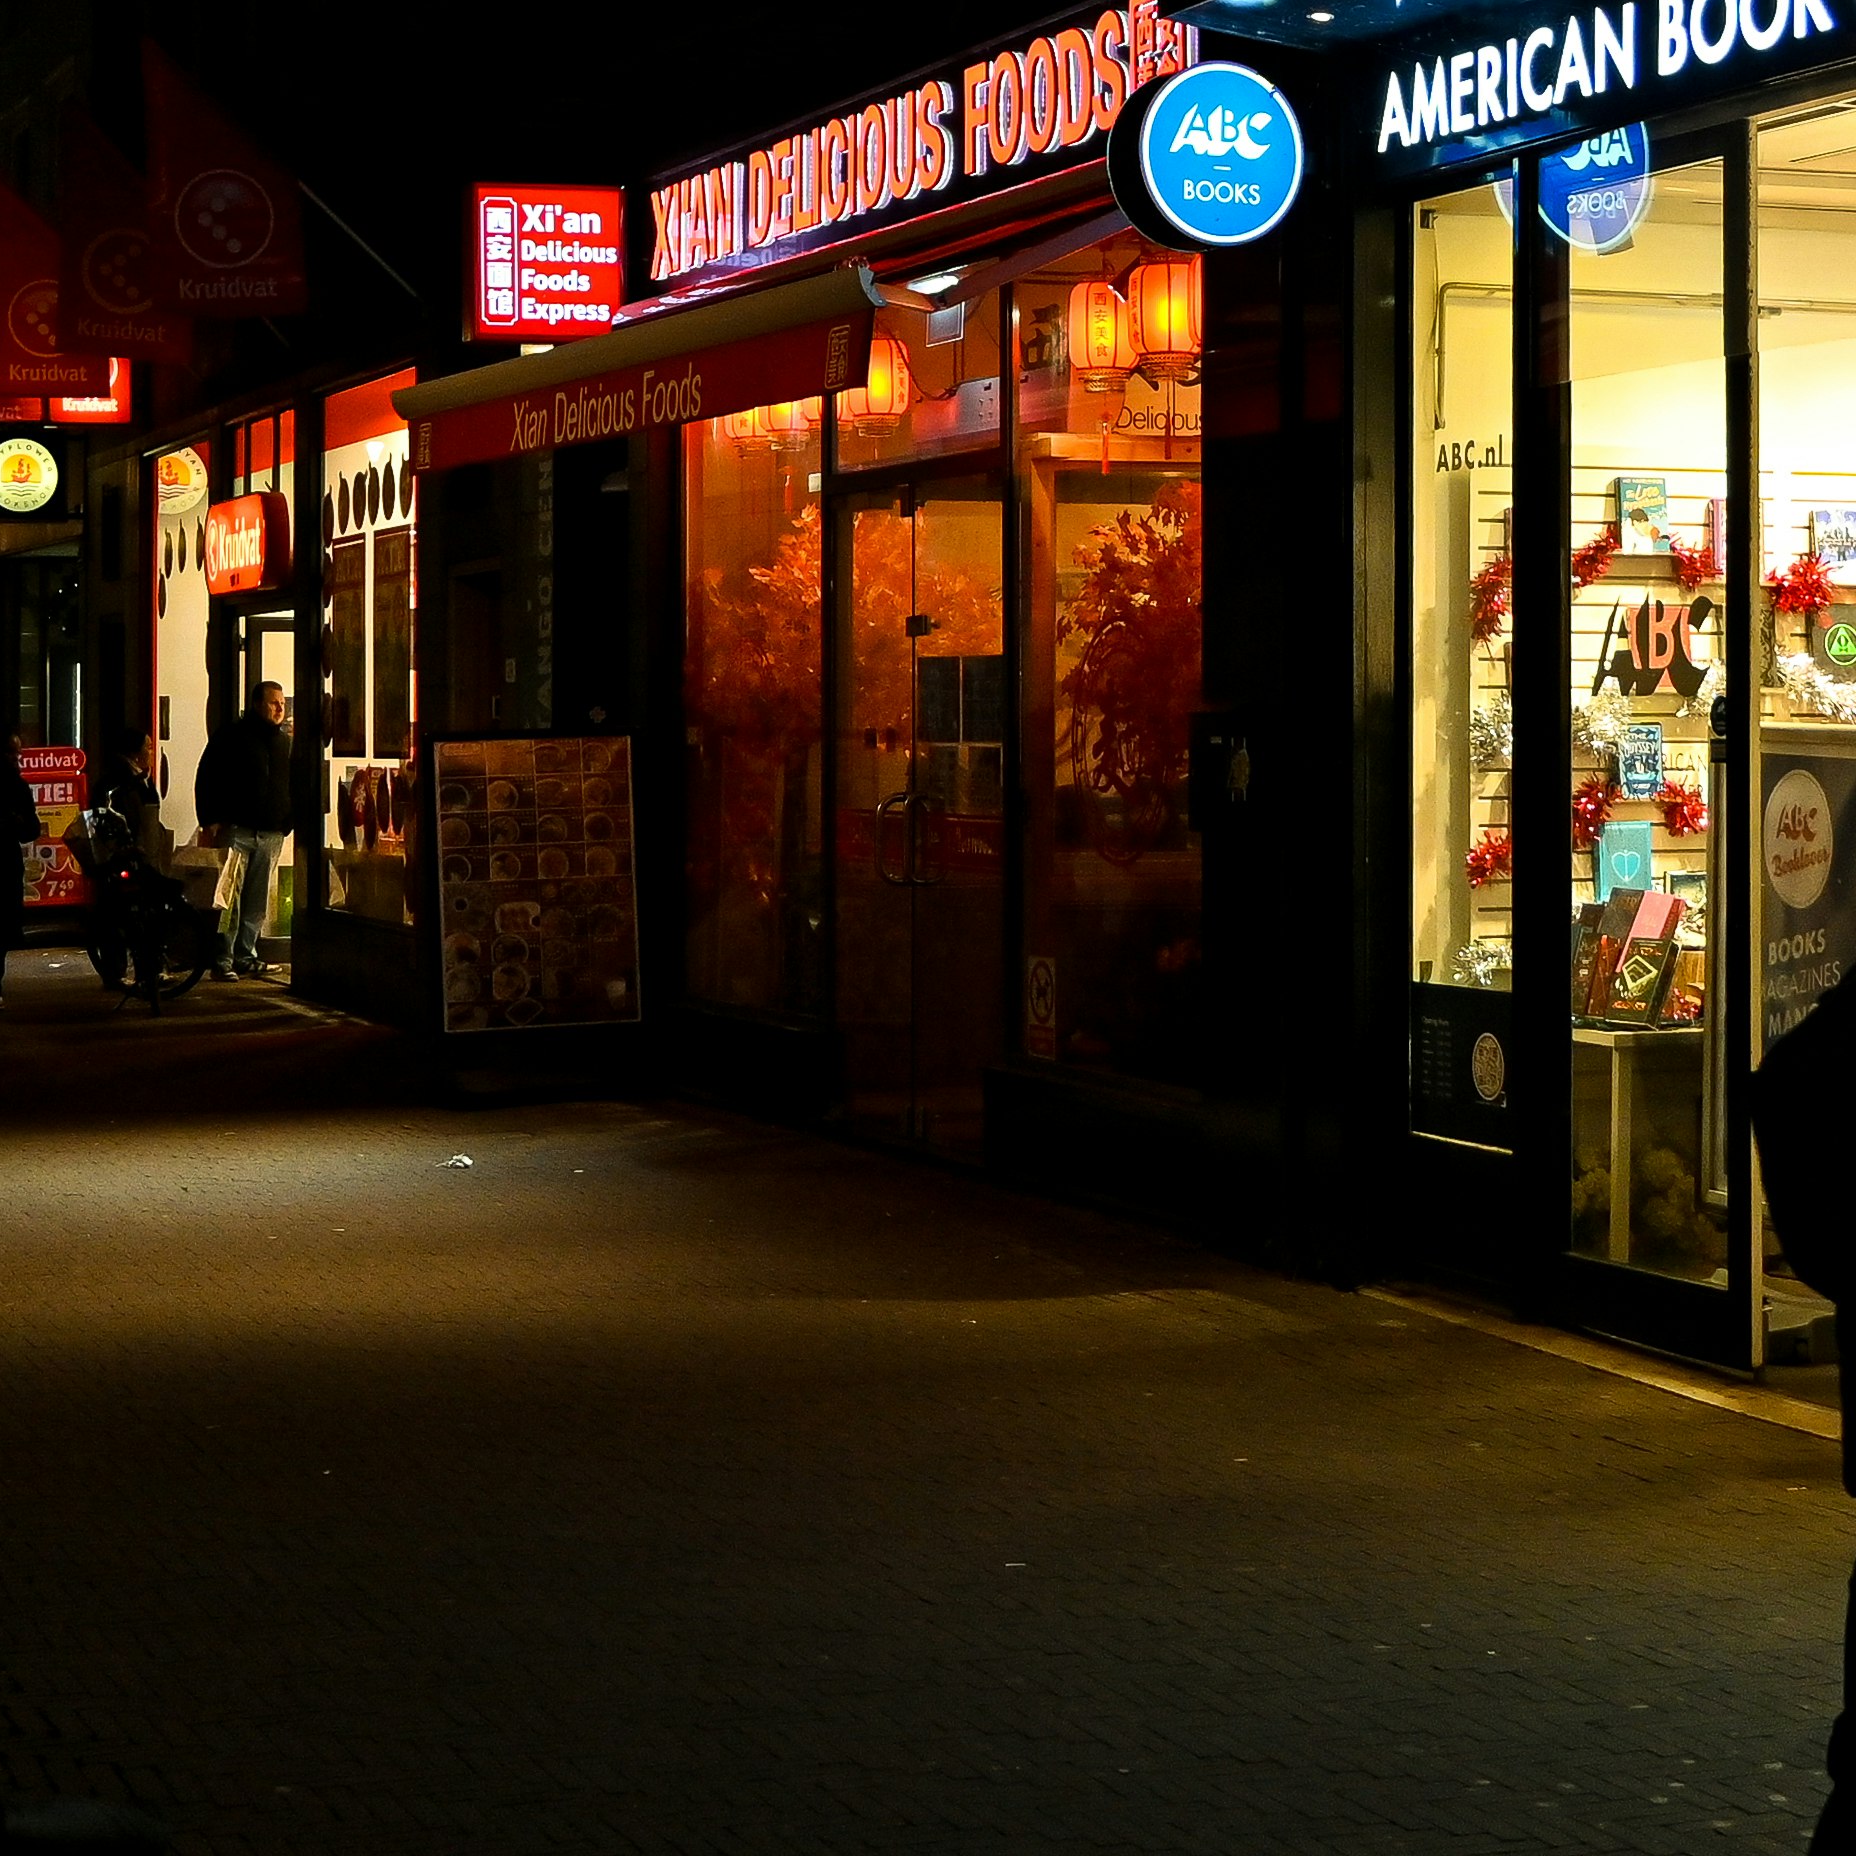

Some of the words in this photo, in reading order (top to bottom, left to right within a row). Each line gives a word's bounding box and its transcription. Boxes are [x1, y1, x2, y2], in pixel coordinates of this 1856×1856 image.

[1376, 0, 1639, 152] AMERICAN
[748, 81, 952, 249] DELICIOUS
[964, 10, 1133, 176] FOODS
[1169, 102, 1273, 160] ABC
[1183, 179, 1261, 205] BOOKS
[521, 204, 602, 234] Xi'an
[520, 239, 618, 263] Delicious
[178, 276, 279, 300] Kruidvat
[520, 268, 591, 292] Foods
[521, 297, 611, 325] Express
[76, 318, 167, 343] Kruidvat
[9, 364, 89, 383] Kruidvat
[510, 401, 546, 452] Xian
[554, 387, 636, 444] Delicious
[642, 362, 702, 427] Foods
[1436, 434, 1504, 473] ABC.nl
[218, 512, 262, 572] Kruidvat
[1592, 591, 1714, 699] ABC
[29, 782, 74, 803] TIE!
[1776, 803, 1818, 842] ABC
[1768, 928, 1827, 966] BOOKS
[1764, 960, 1842, 1001] AGAZINES
